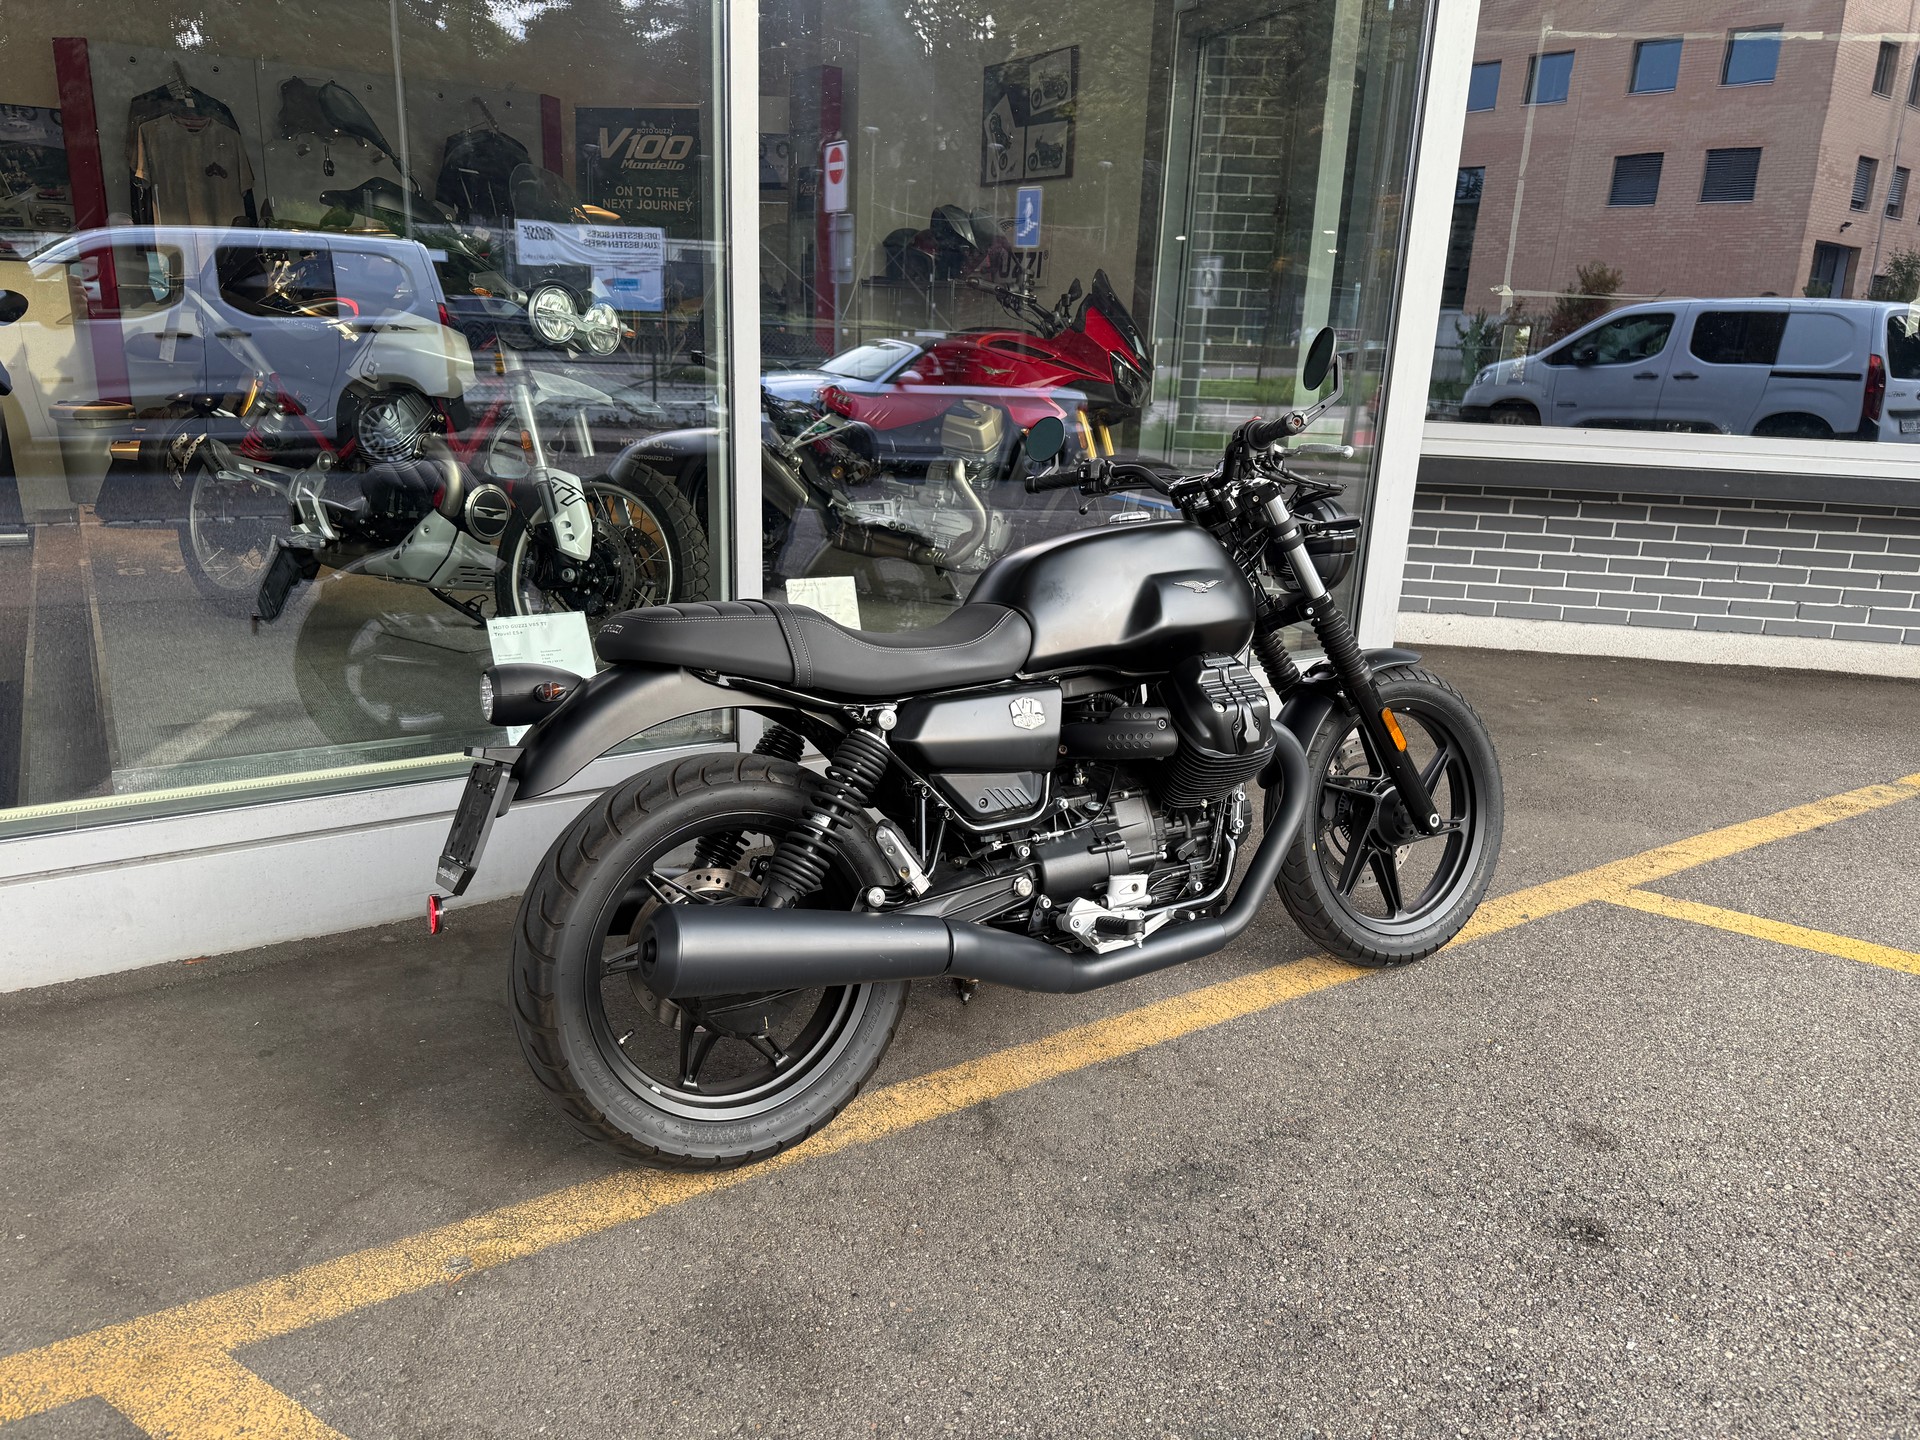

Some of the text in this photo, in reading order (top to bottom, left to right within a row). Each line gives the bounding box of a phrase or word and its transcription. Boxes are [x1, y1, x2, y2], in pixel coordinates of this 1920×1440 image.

[600, 127, 694, 160] V100
[620, 159, 686, 171] Mandello
[615, 186, 679, 198] ON TO THE
[602, 198, 693, 212] NEXT JOURNEY
[280, 317, 299, 325] MOTO
[620, 437, 649, 448] MOTO
[580, 1042, 650, 1122] DUNLOP
